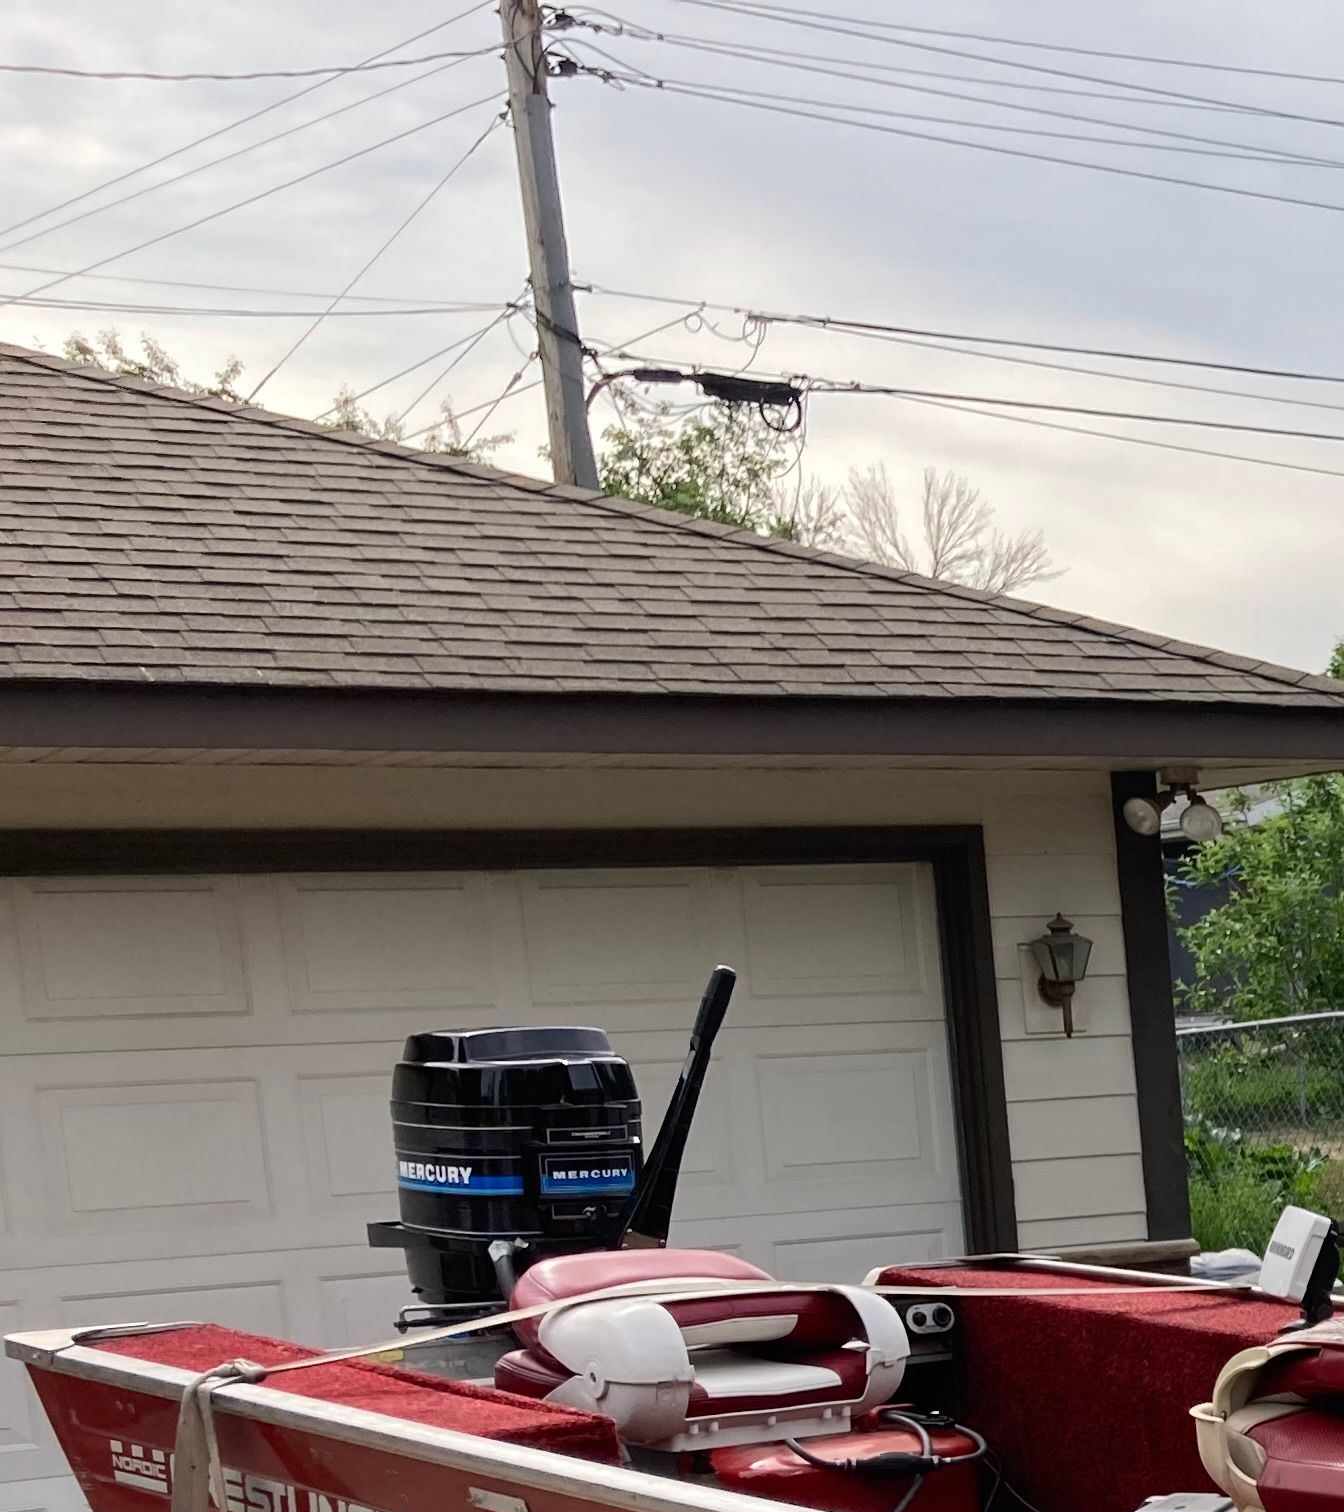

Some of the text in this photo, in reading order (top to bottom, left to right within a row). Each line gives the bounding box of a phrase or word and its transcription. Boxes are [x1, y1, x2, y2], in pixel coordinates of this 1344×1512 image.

[399, 1160, 472, 1185] MERCURY
[552, 1168, 628, 1180] MERCURY
[112, 1453, 167, 1479] NORDIC
